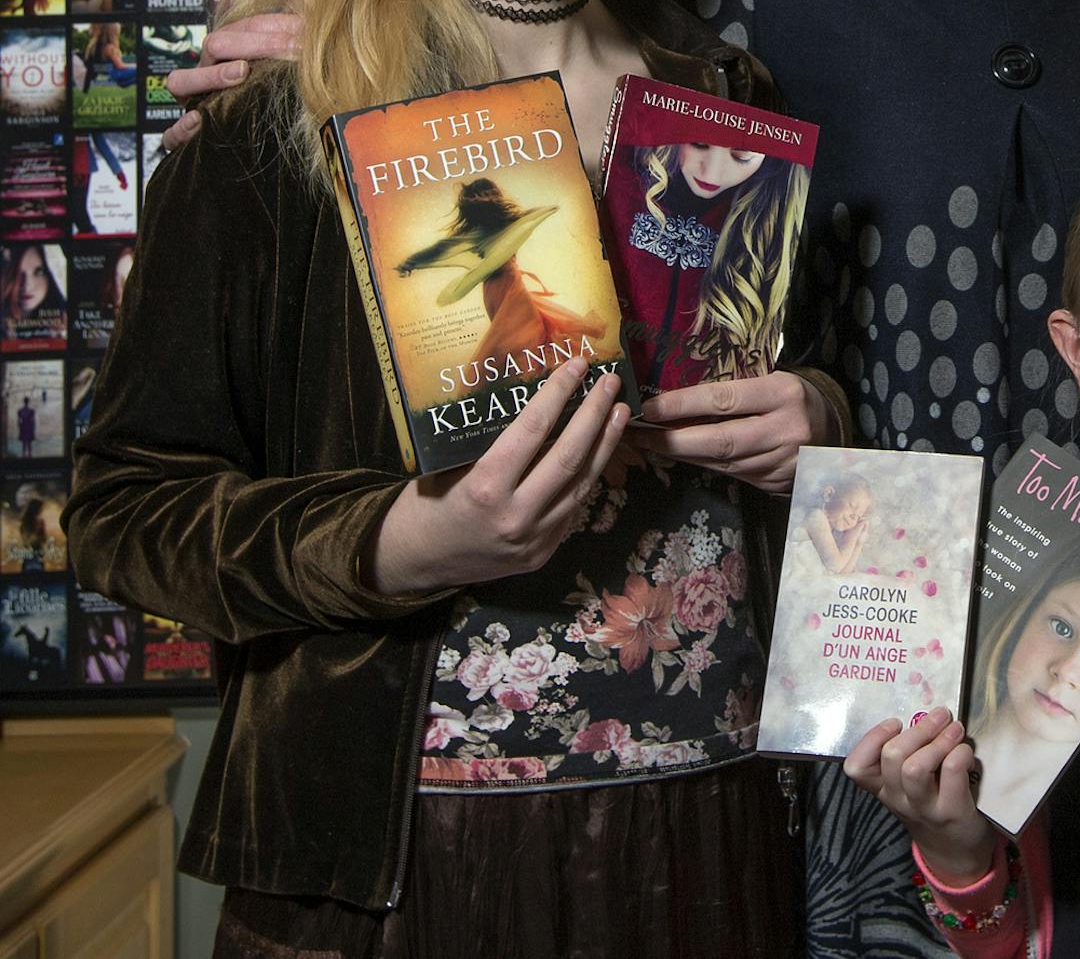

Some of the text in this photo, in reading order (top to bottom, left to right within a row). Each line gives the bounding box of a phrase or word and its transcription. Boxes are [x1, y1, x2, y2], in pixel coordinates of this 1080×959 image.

[1, 54, 66, 64] WITHOUT
[0, 67, 66, 88] YOU
[423, 109, 496, 142] THE
[642, 90, 803, 146] MARIE-LOUISE JENSEN
[366, 129, 563, 196] FIREBIRD
[439, 334, 598, 393] SUSANNA
[1016, 448, 1063, 501] Too
[997, 505, 1051, 547] The inspiring
[1004, 534, 1027, 553] story
[1027, 550, 1039, 560] of
[990, 547, 1022, 573] woman
[838, 584, 908, 604] CAROLYN
[1003, 580, 1017, 593] on
[822, 603, 918, 624] JESS-COOKE
[831, 624, 903, 643] JOURNAL
[823, 642, 907, 663] D'UN ANGE
[828, 663, 897, 683] GARDIEN
